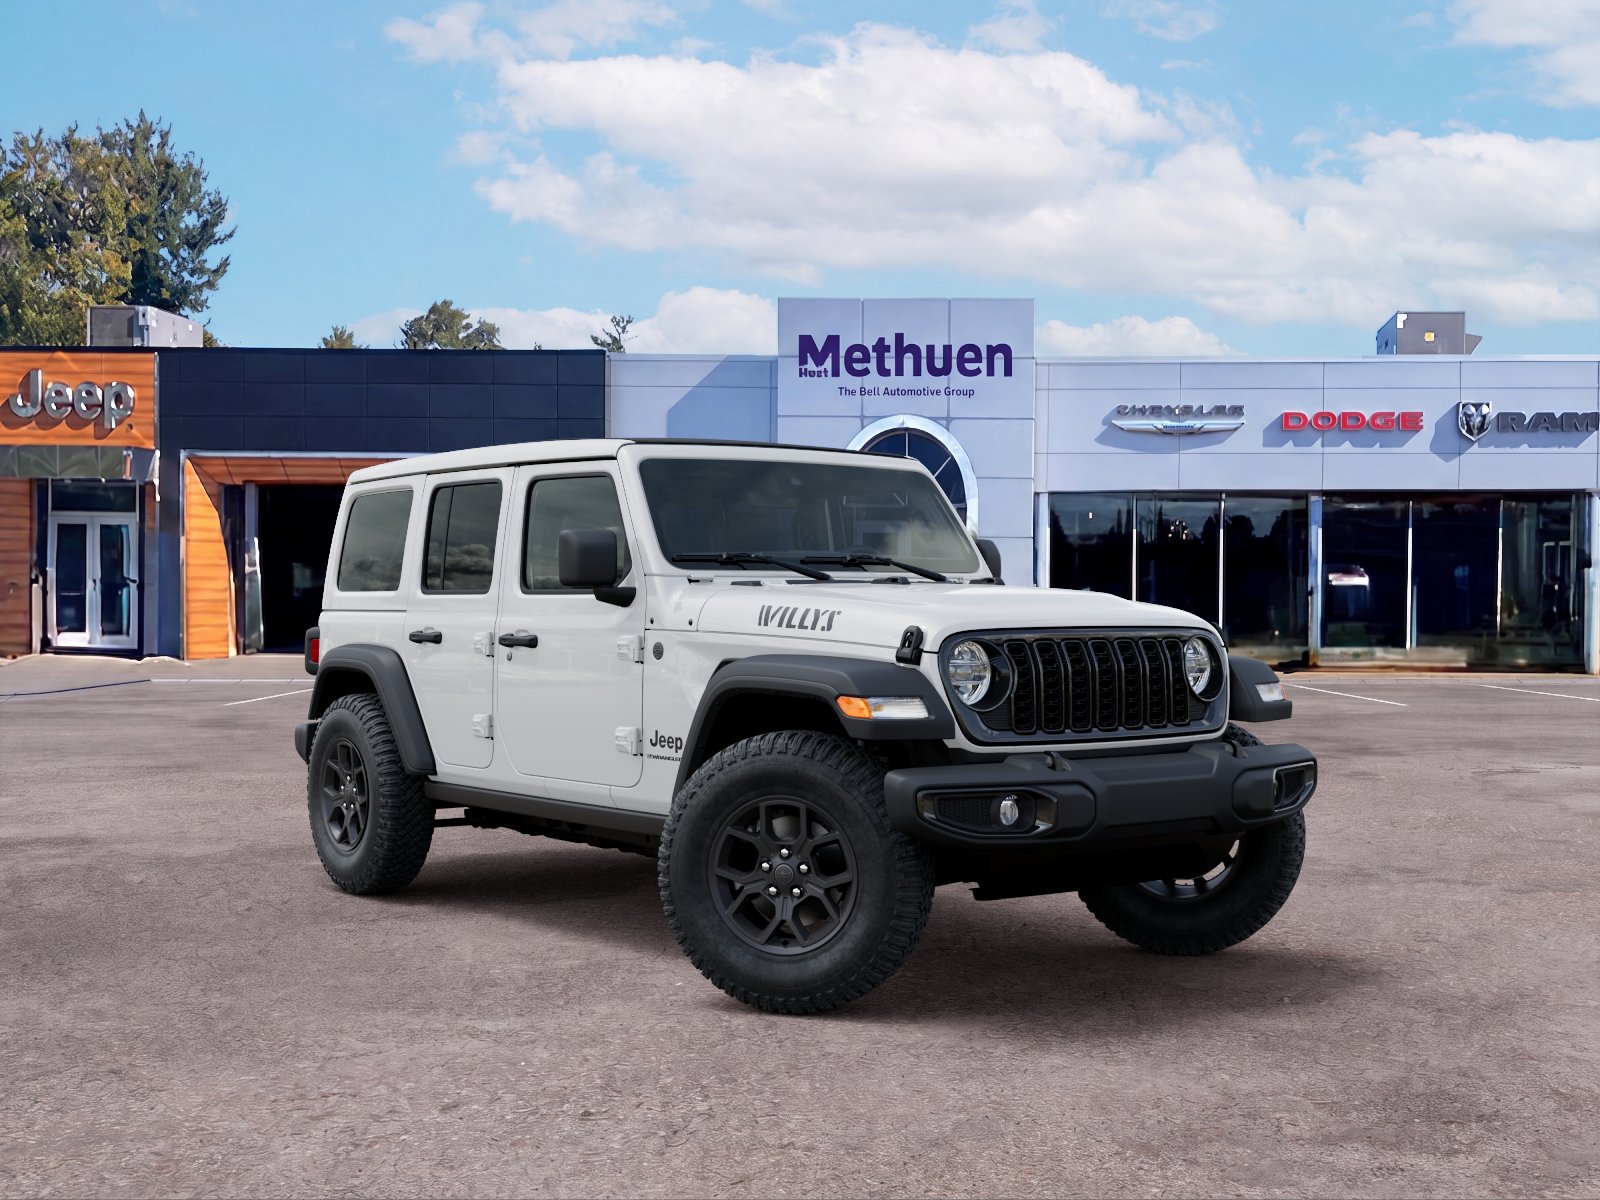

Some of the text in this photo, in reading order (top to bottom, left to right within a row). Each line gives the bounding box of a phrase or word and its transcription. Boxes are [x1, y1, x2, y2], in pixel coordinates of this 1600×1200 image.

[798, 333, 1013, 377] Methuen
[9, 368, 135, 429] Jeep
[838, 386, 975, 398] The Bell Automotive Group
[1282, 411, 1424, 431] DODGE
[1498, 411, 1599, 432] RAM
[758, 605, 842, 631] WILLYS
[650, 730, 683, 753] Jeep
